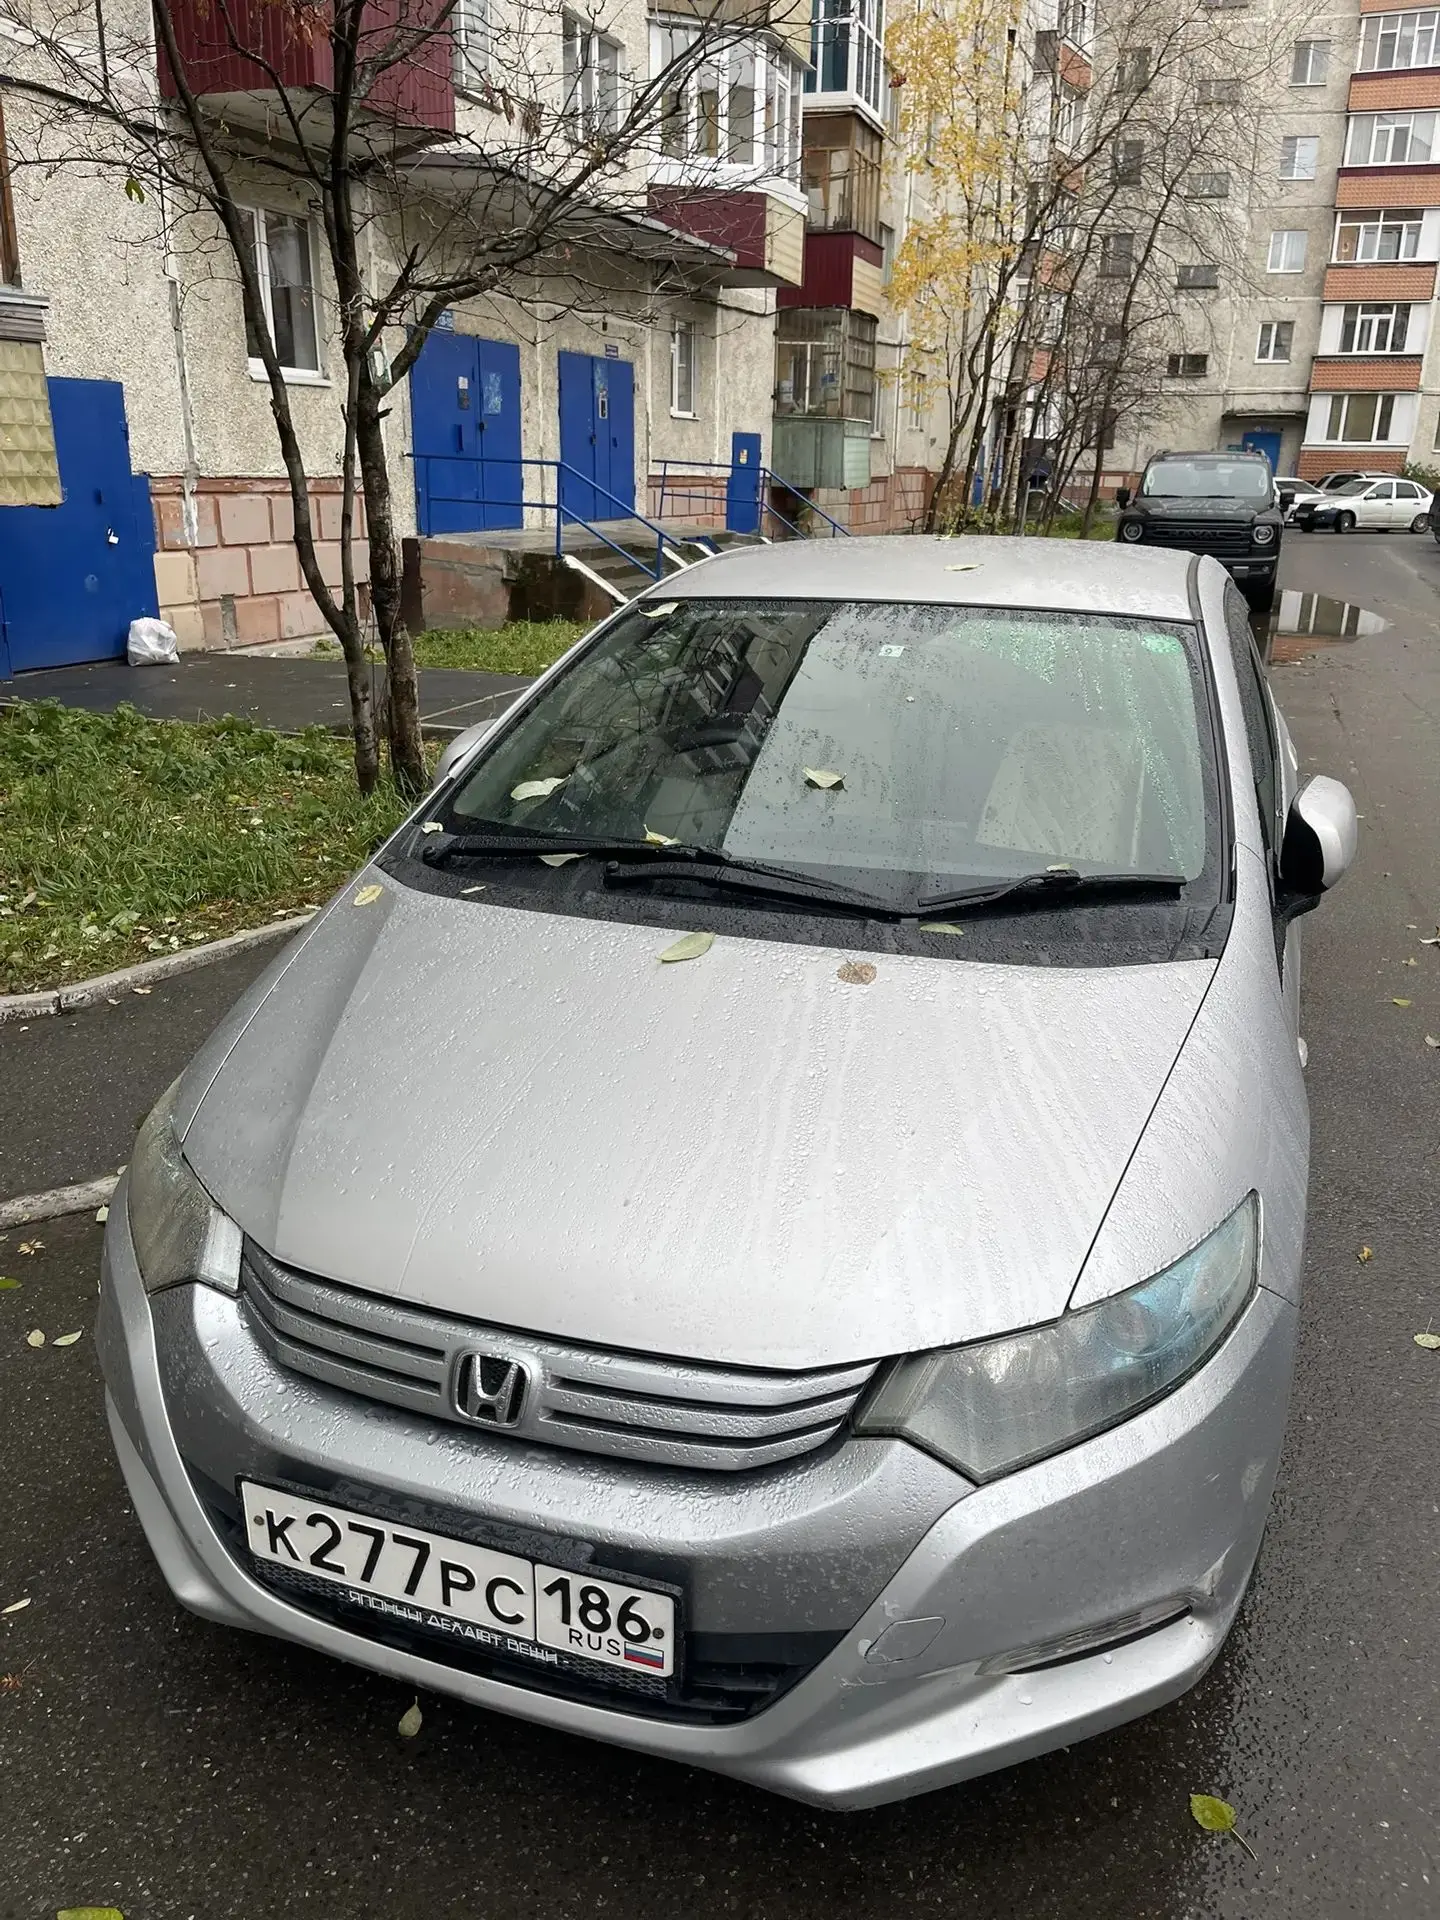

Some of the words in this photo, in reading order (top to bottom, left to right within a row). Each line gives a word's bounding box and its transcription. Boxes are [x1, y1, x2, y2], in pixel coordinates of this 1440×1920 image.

[349, 1590, 423, 1623] ЯПОНЦЫ
[427, 1614, 502, 1646] ДЕЛАЮТ
[543, 1576, 652, 1643] 186
[568, 1628, 621, 1657] RUS
